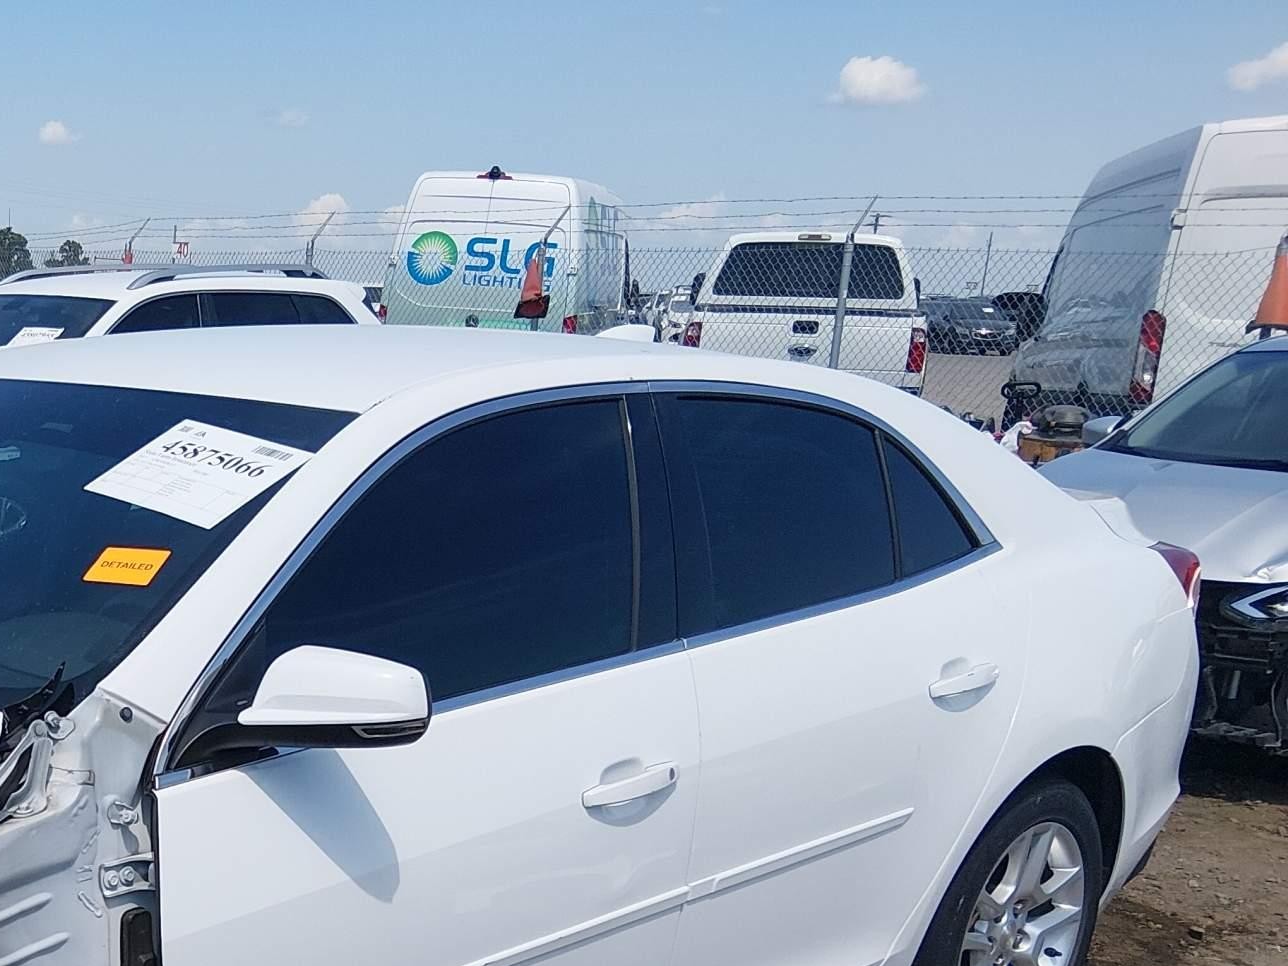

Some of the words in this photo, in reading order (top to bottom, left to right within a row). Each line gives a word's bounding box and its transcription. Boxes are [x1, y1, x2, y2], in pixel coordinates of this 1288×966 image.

[176, 243, 189, 258] 40
[464, 237, 558, 278] SLG
[462, 273, 552, 292] LIGHTIG
[161, 440, 273, 478] 45875066
[100, 560, 154, 571] DETAILED
